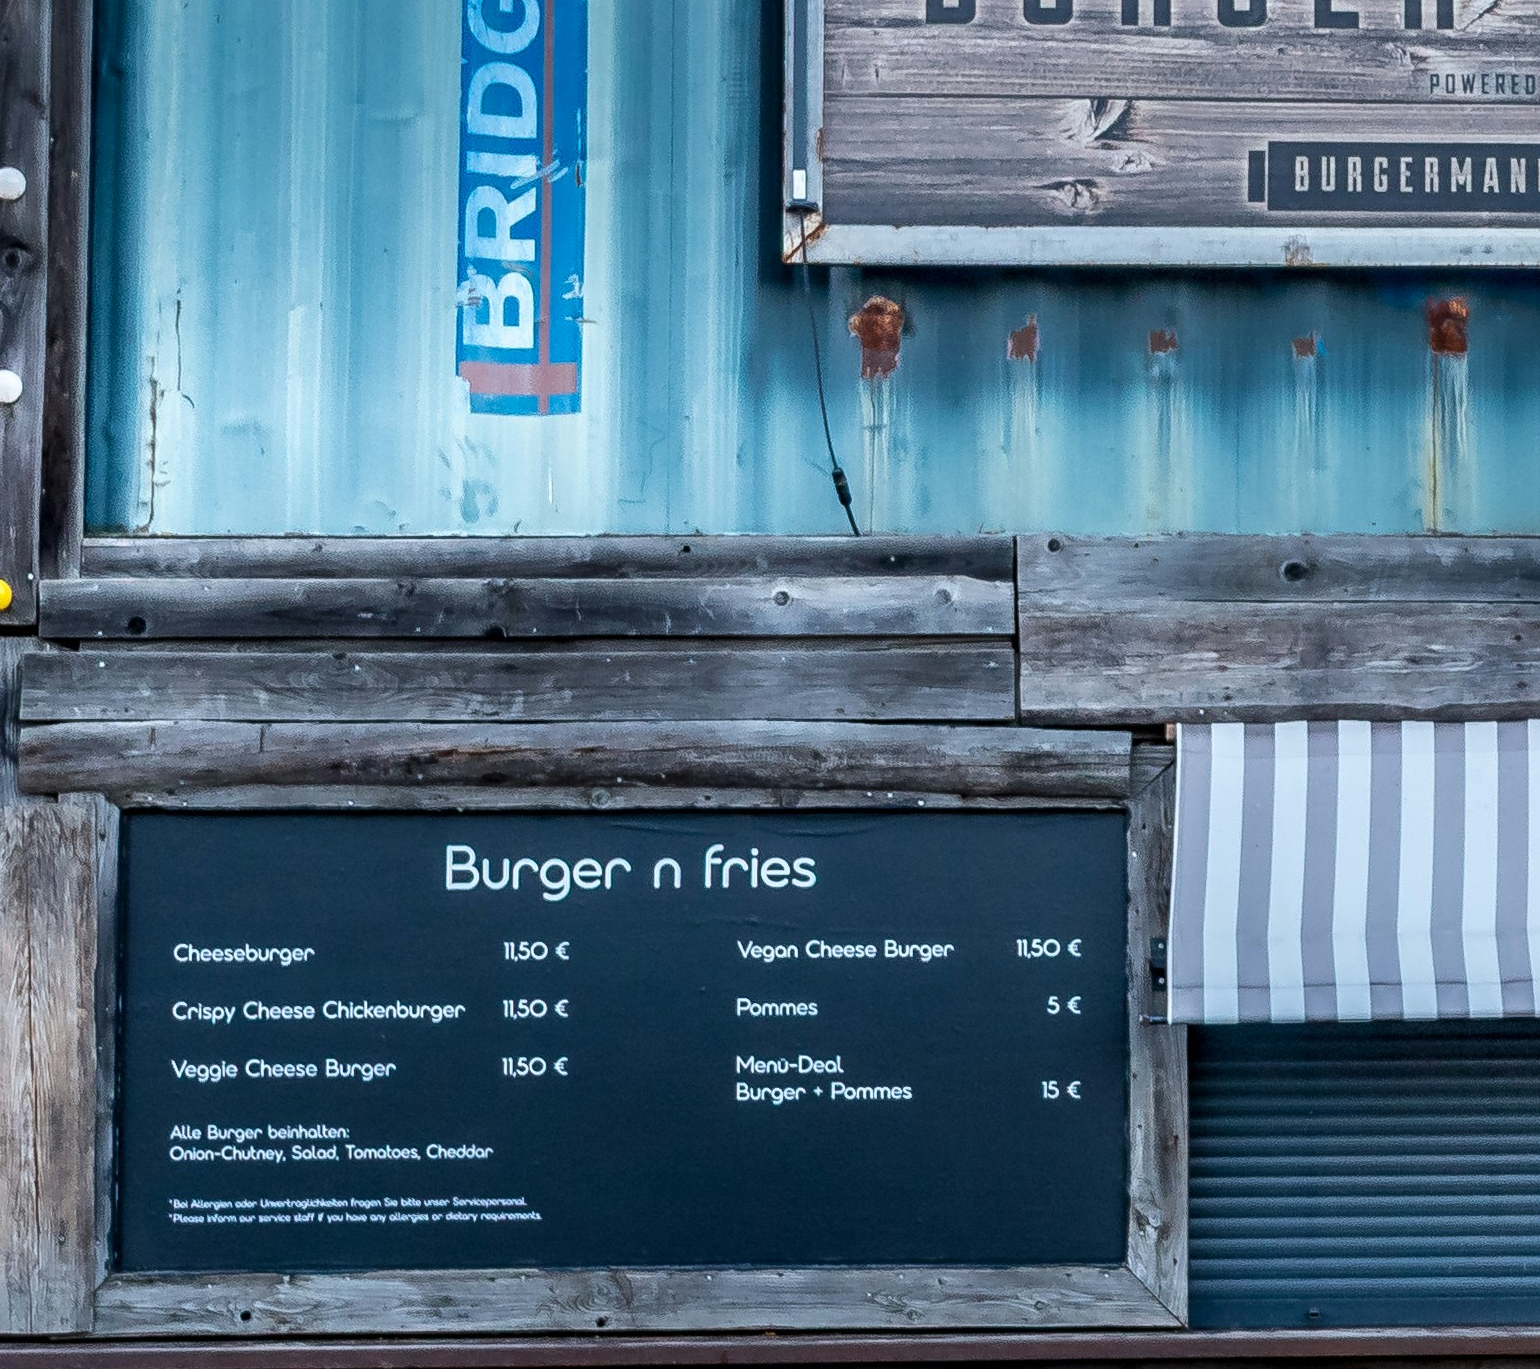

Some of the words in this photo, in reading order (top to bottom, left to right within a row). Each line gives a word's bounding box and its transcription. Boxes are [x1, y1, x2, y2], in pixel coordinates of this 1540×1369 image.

[1430, 73, 1536, 95] POWERED
[445, 844, 632, 902] Burger
[653, 857, 682, 890] n
[704, 843, 817, 889] fries
[173, 942, 316, 968] Cheeseburger
[503, 940, 549, 963] 11,50
[555, 940, 571, 961] €
[736, 939, 799, 964] Vegan
[805, 939, 878, 959] Cheese
[883, 938, 956, 963] Burger
[1015, 937, 1061, 960] 11,50
[1066, 938, 1083, 958] €
[171, 1000, 237, 1026] Crispy
[242, 1000, 316, 1021] Cheese
[321, 999, 467, 1024] Chickenburger
[502, 998, 548, 1021] 11,50
[554, 998, 570, 1019] €
[735, 997, 819, 1018] Pommes
[1046, 995, 1061, 1016] 5
[1065, 995, 1082, 1015] €
[170, 1058, 239, 1084] Veggie
[244, 1058, 319, 1079] Cheese
[324, 1057, 397, 1083] Burger
[501, 1056, 547, 1079] 11,50
[553, 1056, 569, 1077] €
[735, 1054, 845, 1075] Menü-Deal
[735, 1081, 807, 1106] Burger
[812, 1086, 824, 1097] +
[830, 1080, 913, 1101] Pommes
[1041, 1079, 1060, 1100] 15
[1066, 1080, 1082, 1100] €
[170, 1124, 202, 1140] Alle
[207, 1124, 263, 1143] Burger
[267, 1124, 350, 1140] beinhalten:
[169, 1144, 287, 1164] Onion-Chutney,
[291, 1144, 340, 1162] Salad,
[345, 1143, 422, 1161] Tomatoes,
[426, 1143, 495, 1160] Cheddar
[191, 1199, 233, 1211] Allergien
[235, 1198, 258, 1209] oder
[350, 1197, 382, 1210] fragen
[424, 1198, 450, 1207] unser
[207, 1212, 238, 1224] inform
[239, 1214, 256, 1223] our
[259, 1213, 292, 1223] service
[294, 1212, 315, 1224] staff
[326, 1213, 344, 1225] you
[345, 1211, 368, 1223] have
[370, 1213, 387, 1224] any
[389, 1211, 430, 1224] allergies
[431, 1213, 444, 1222] or
[445, 1211, 479, 1224] dietary
